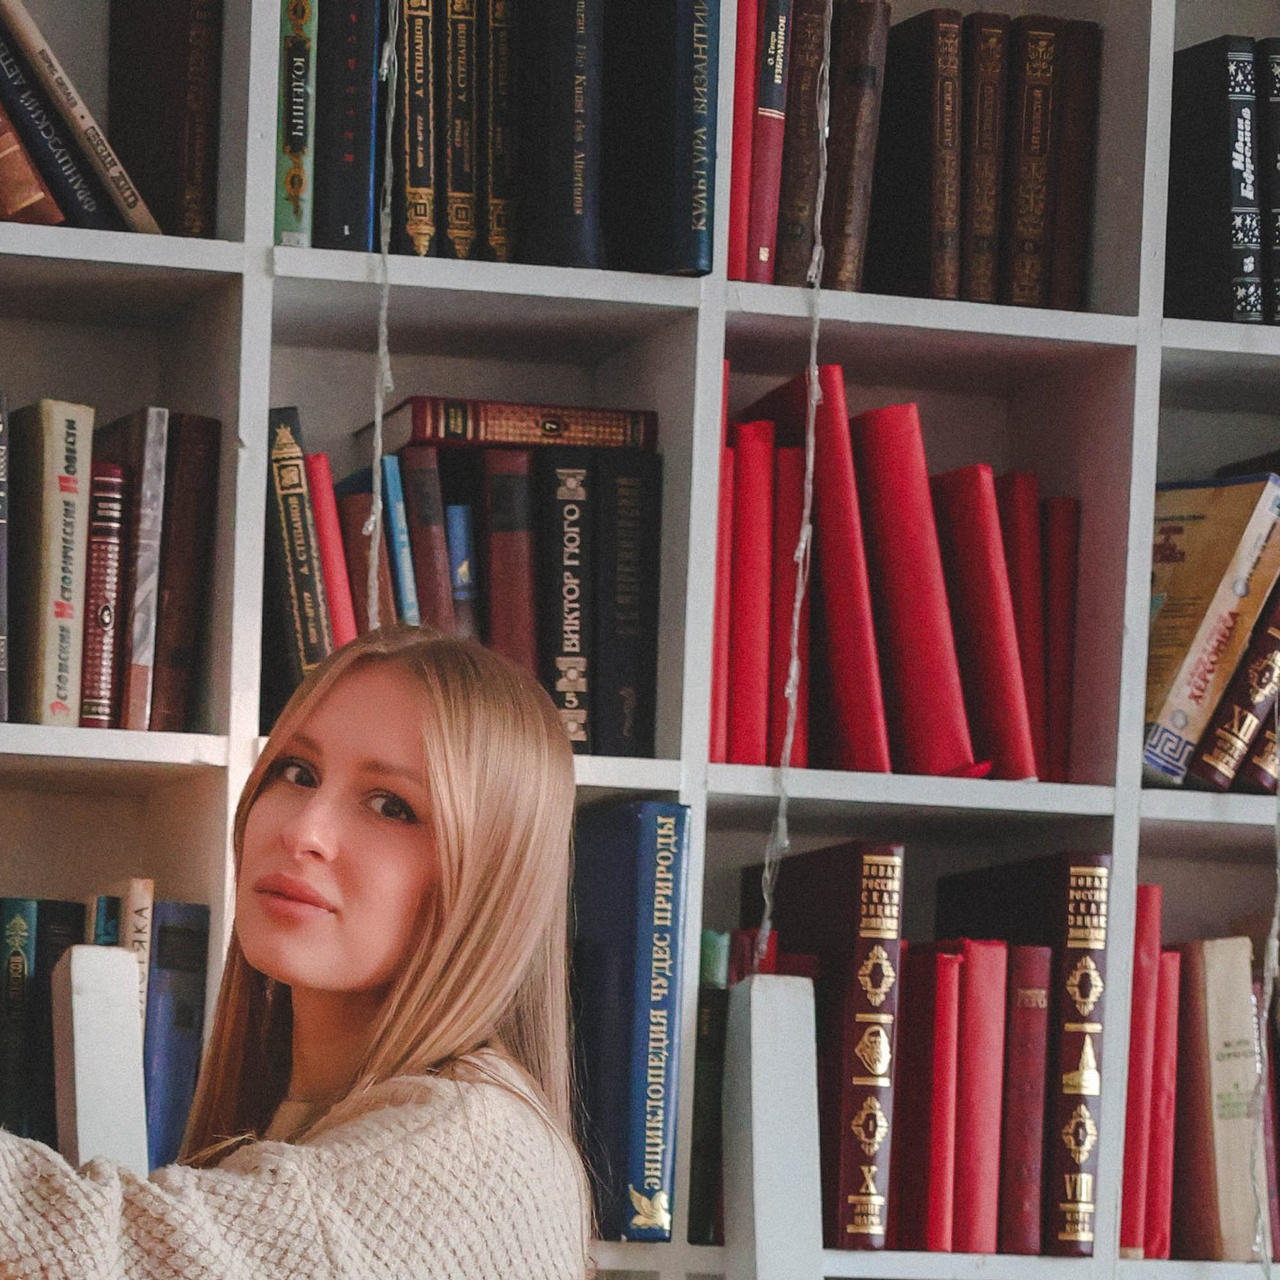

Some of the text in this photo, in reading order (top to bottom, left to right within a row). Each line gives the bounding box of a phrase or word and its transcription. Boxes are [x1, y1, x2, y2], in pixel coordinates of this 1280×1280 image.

[414, 17, 424, 83] СТЕПАНОВ
[455, 22, 468, 87] СТЕПАНОВ
[773, 14, 789, 84] ИЗБРАННОЕ
[287, 56, 308, 137] ЮДЕНИЧ
[16, 87, 100, 215] ФРАНЦУЗСКИЙ
[691, 125, 709, 231] КУЛЬТУРА
[107, 169, 143, 211] ЖИТЬ
[286, 494, 311, 561] СТЕПАНОВ
[562, 503, 580, 652] ВИКТОР ГЮГО
[861, 890, 900, 904] СКАЯ
[863, 865, 901, 879] НОВАЯ
[1070, 876, 1109, 889] НОВАЯ
[1068, 902, 1108, 915] СКАЯ
[641, 816, 678, 1191] ЭНЦИКЛОПЕДИЯ ЧУДЕС ПРИРОДЫ
[859, 1165, 878, 1194] X
